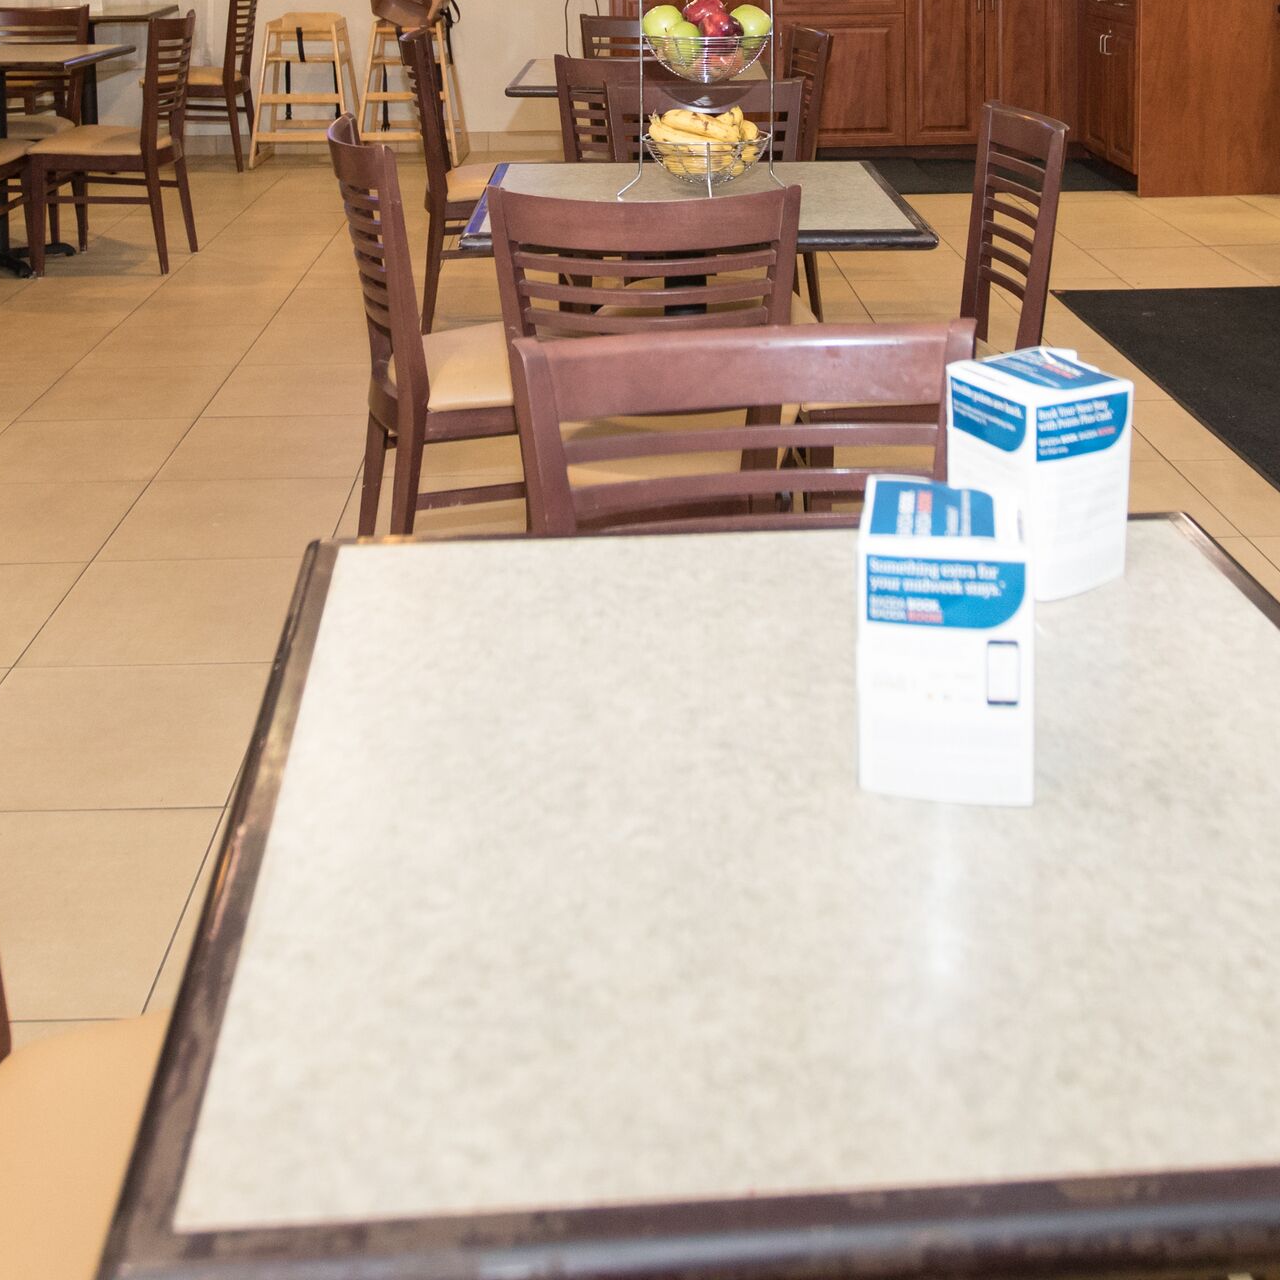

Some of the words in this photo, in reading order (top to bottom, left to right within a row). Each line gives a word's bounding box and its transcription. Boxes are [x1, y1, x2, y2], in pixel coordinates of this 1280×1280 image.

[1038, 421, 1057, 432] with
[870, 558, 940, 580] Something
[940, 562, 977, 579] extra
[977, 563, 1000, 579] for
[870, 576, 901, 592] your
[902, 578, 964, 596] midweek
